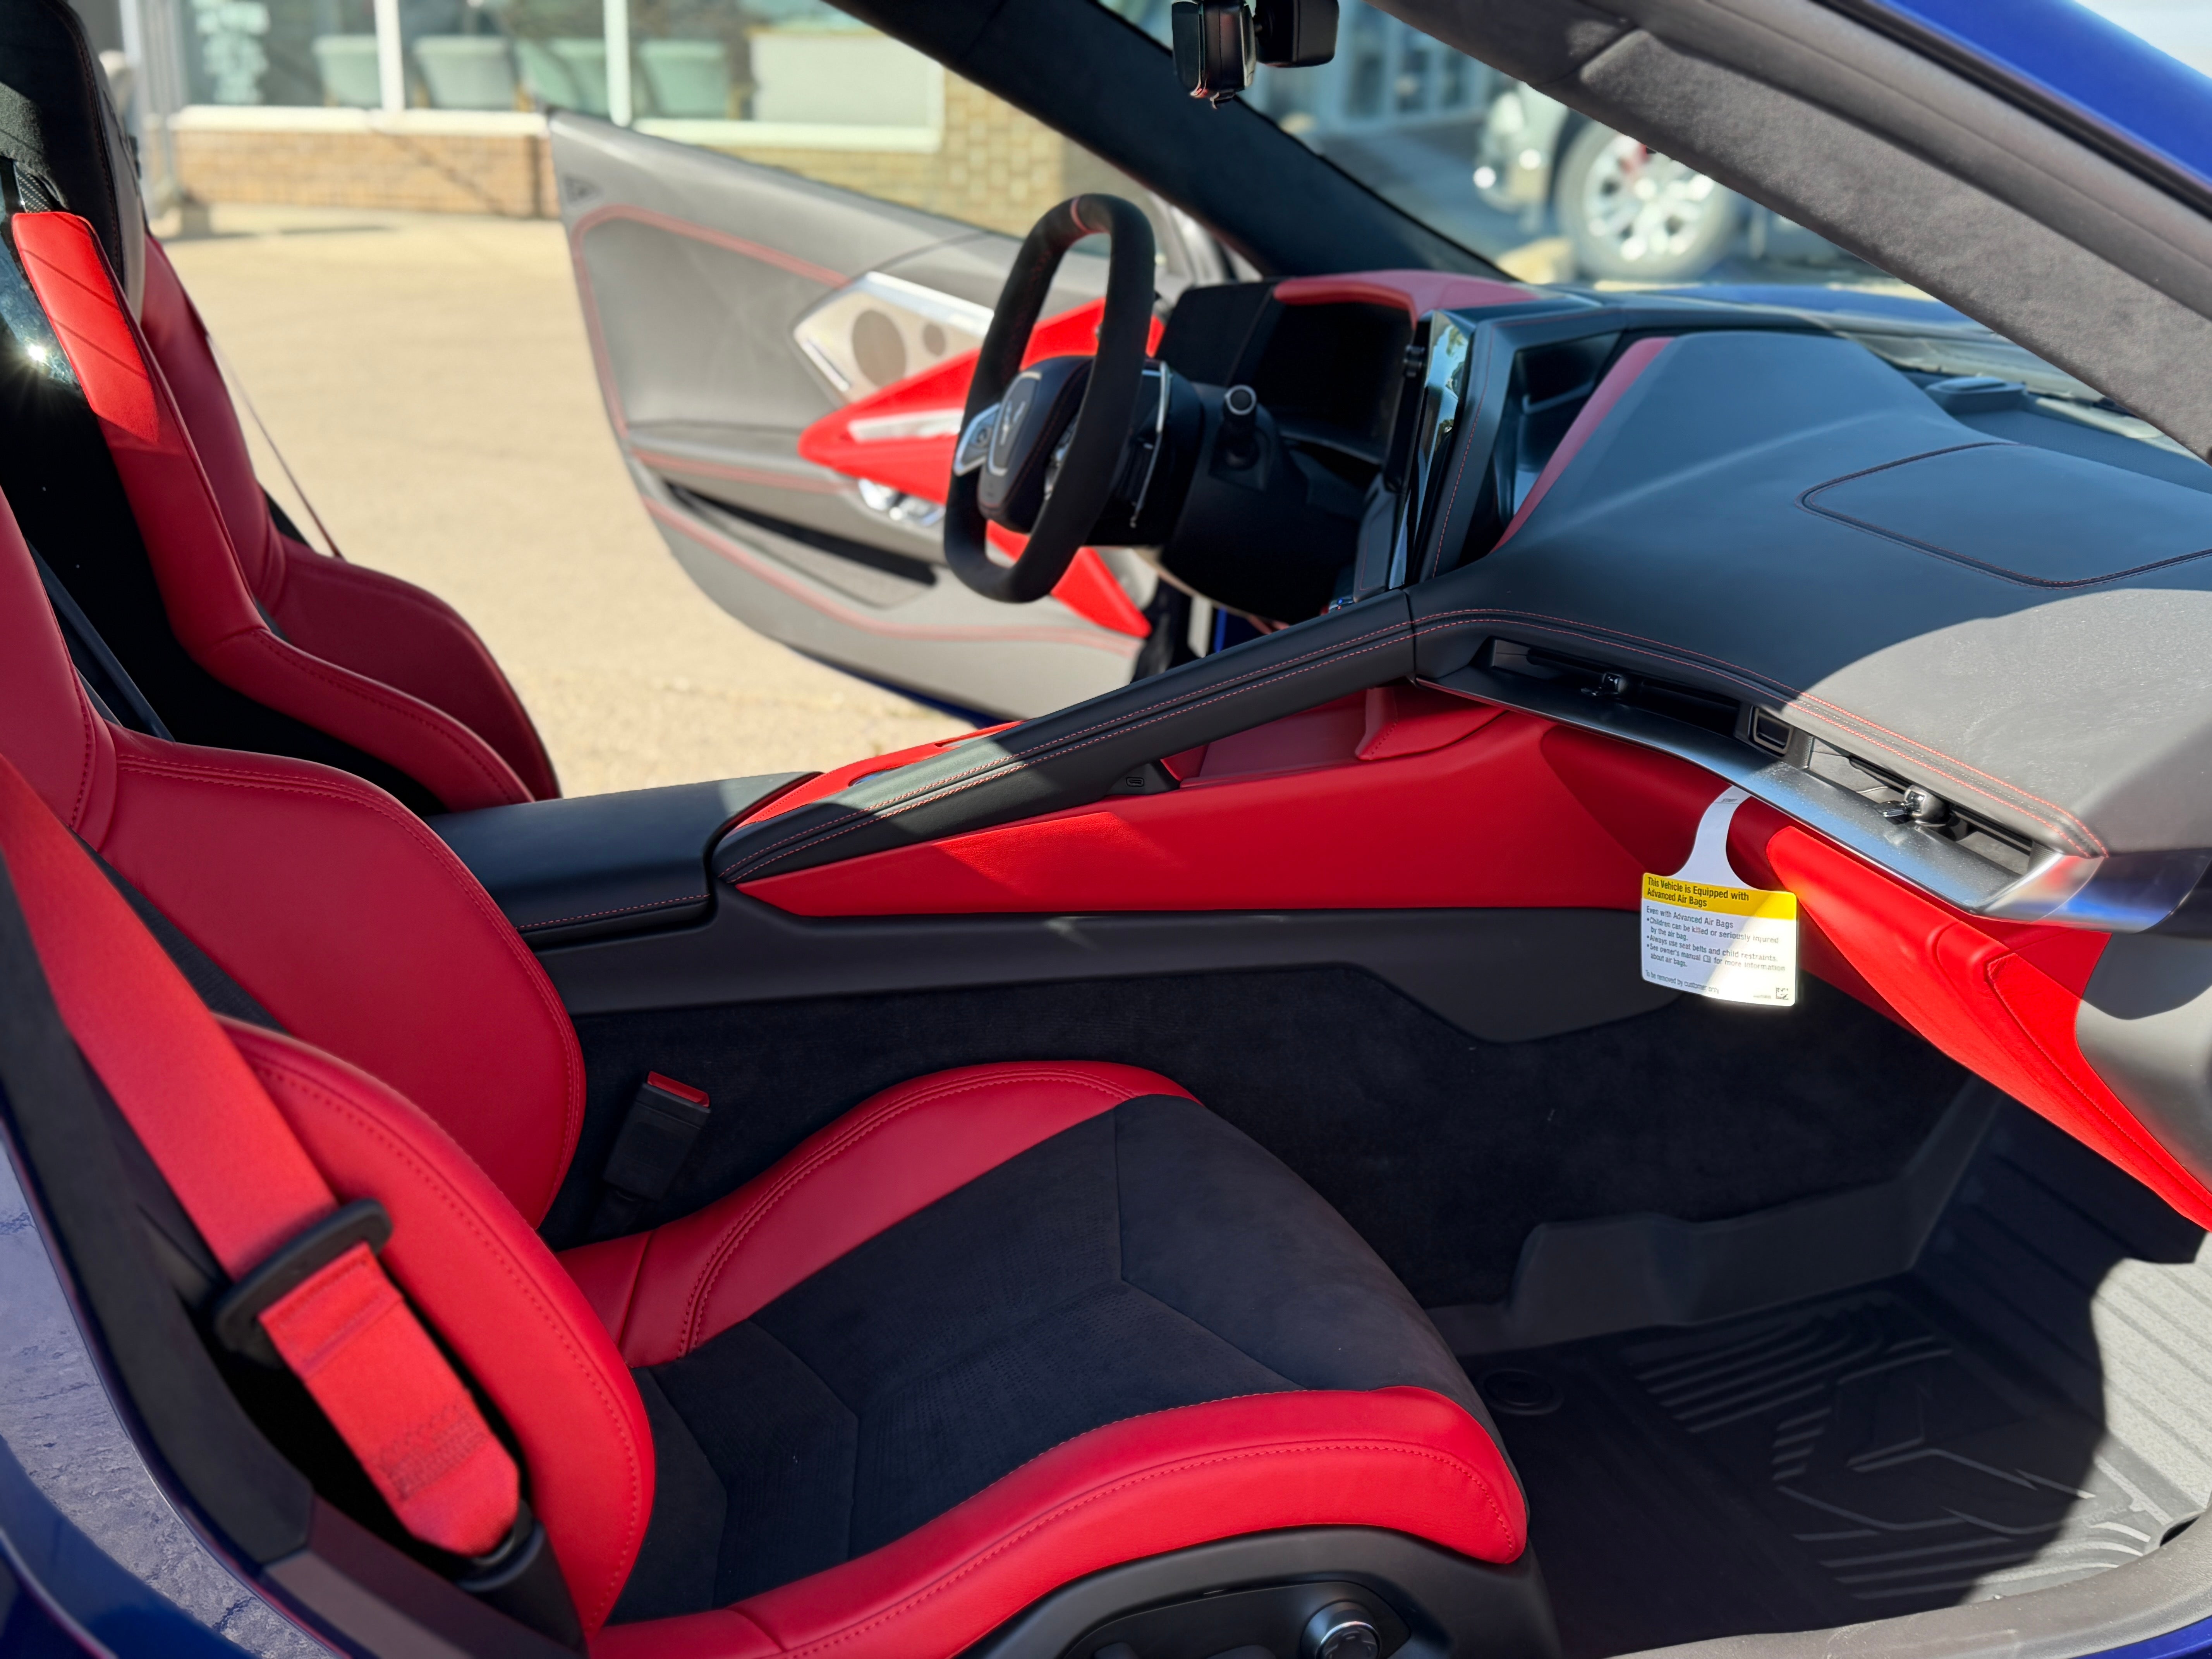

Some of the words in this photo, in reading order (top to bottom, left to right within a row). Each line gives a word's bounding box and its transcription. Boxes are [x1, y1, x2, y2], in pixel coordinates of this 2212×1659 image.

[1648, 877, 1659, 887] This
[1661, 879, 1683, 892] Vehicle
[1685, 884, 1691, 893] is
[1693, 886, 1728, 898] Equipped
[1731, 891, 1749, 901] with
[1647, 888, 1676, 901] Advanced
[1678, 895, 1687, 903] Air
[1689, 896, 1707, 908] Bags
[1647, 906, 1659, 915] Even
[1673, 912, 1702, 924] Advanced
[1716, 919, 1733, 929] Bags
[1651, 926, 1657, 934] by
[1719, 931, 1750, 942] seriously
[1753, 935, 1779, 943] injured
[1693, 944, 1707, 953] belts
